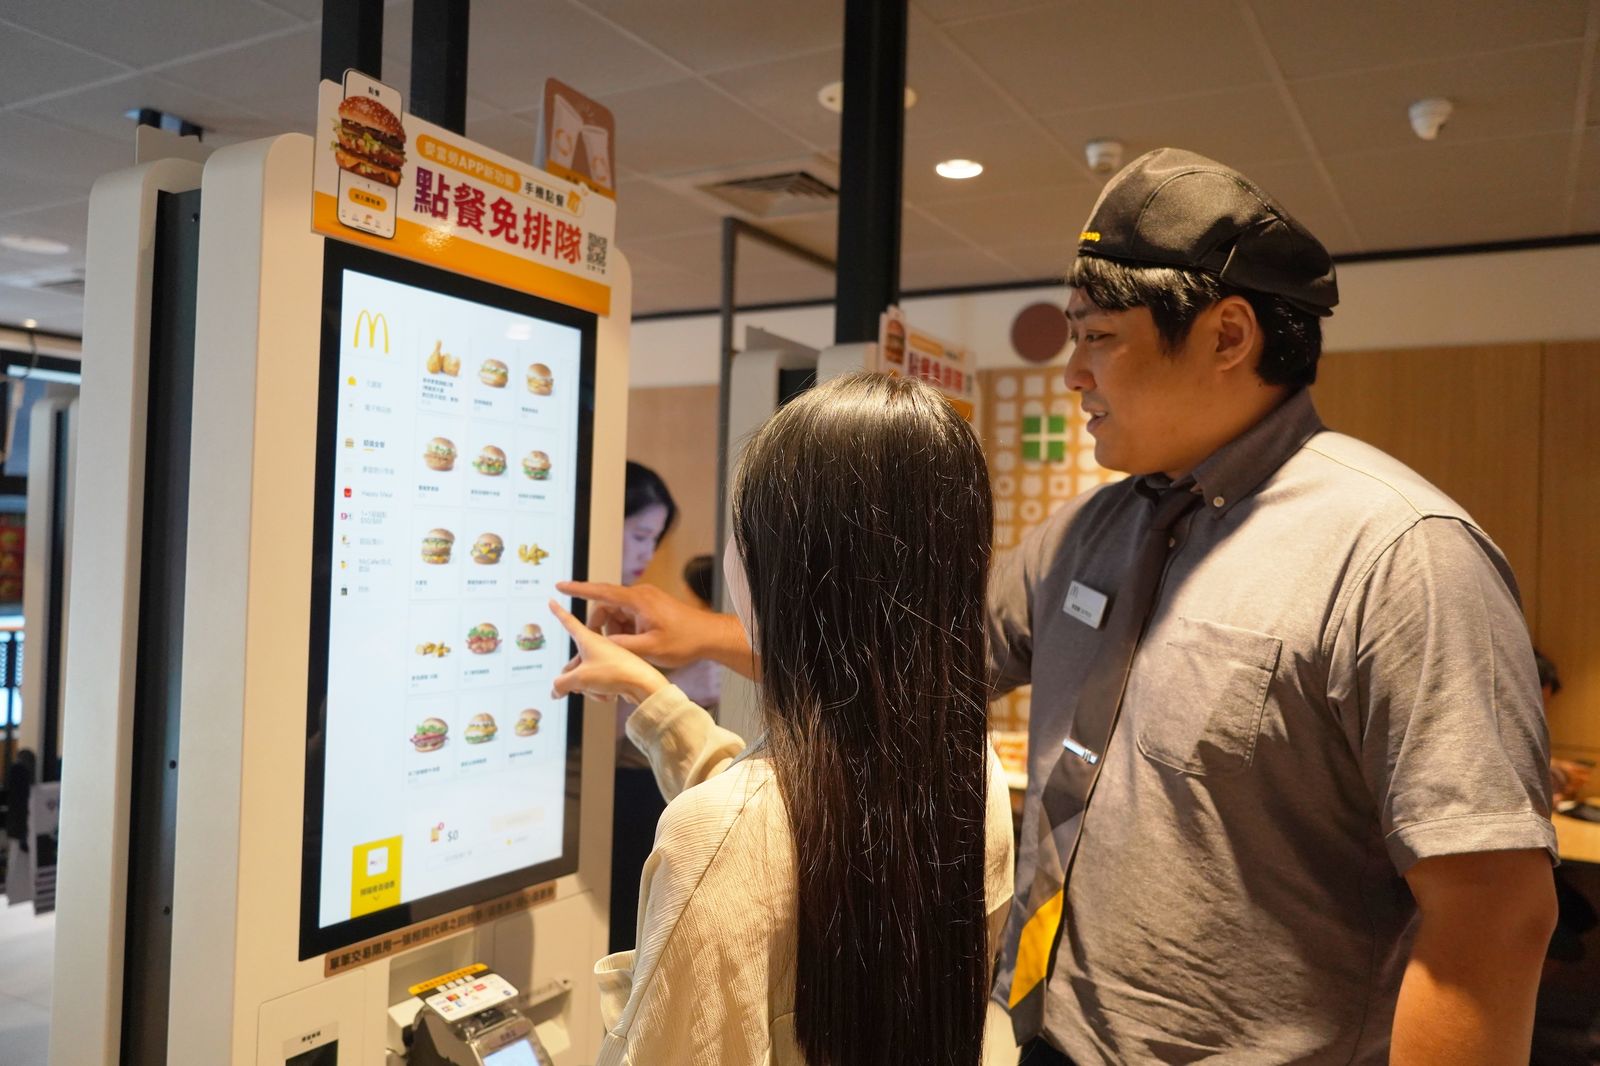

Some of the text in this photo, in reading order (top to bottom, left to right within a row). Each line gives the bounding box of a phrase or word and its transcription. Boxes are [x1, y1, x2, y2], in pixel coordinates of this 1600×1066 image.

[413, 165, 582, 265] 點餐免排隊
[524, 181, 565, 207] 手機點餐
